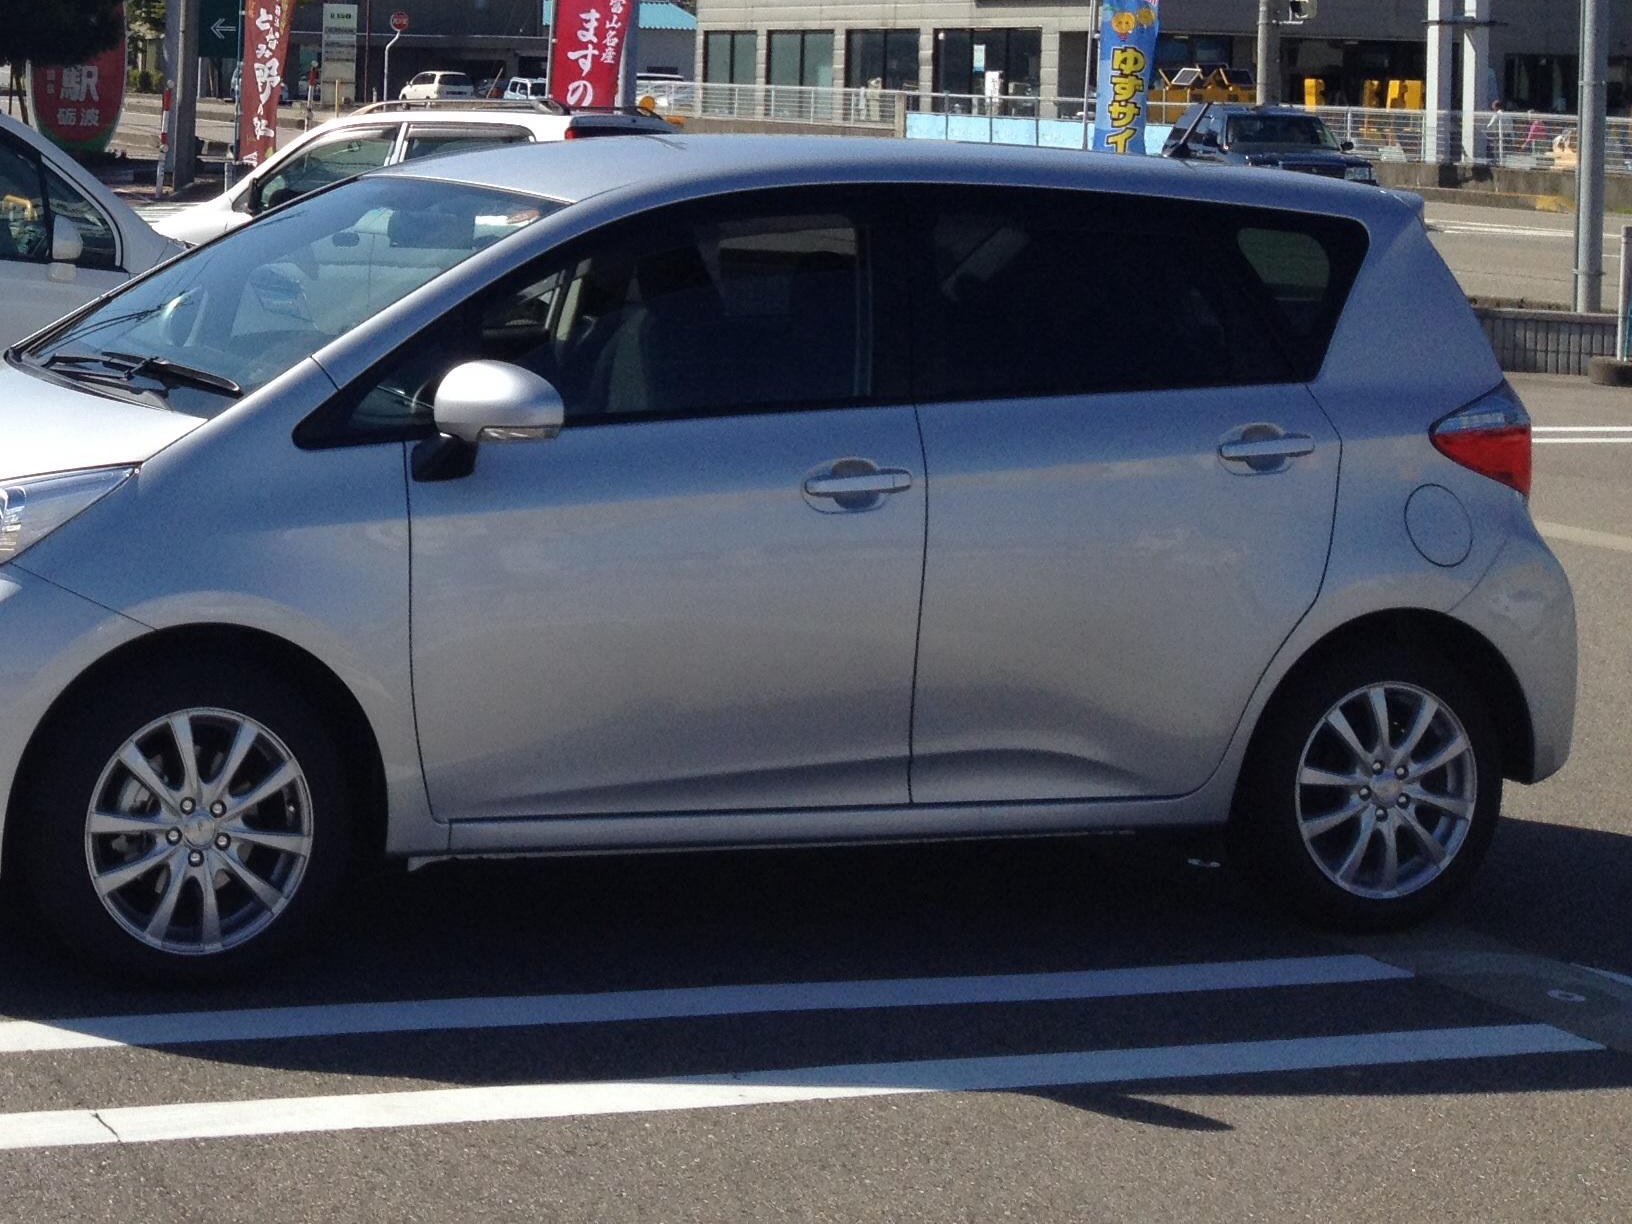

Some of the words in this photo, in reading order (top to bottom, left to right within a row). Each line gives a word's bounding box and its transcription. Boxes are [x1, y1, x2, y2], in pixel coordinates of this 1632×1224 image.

[566, 8, 601, 107] ますの
[59, 64, 100, 103] 駅
[56, 107, 100, 126] 砺波
